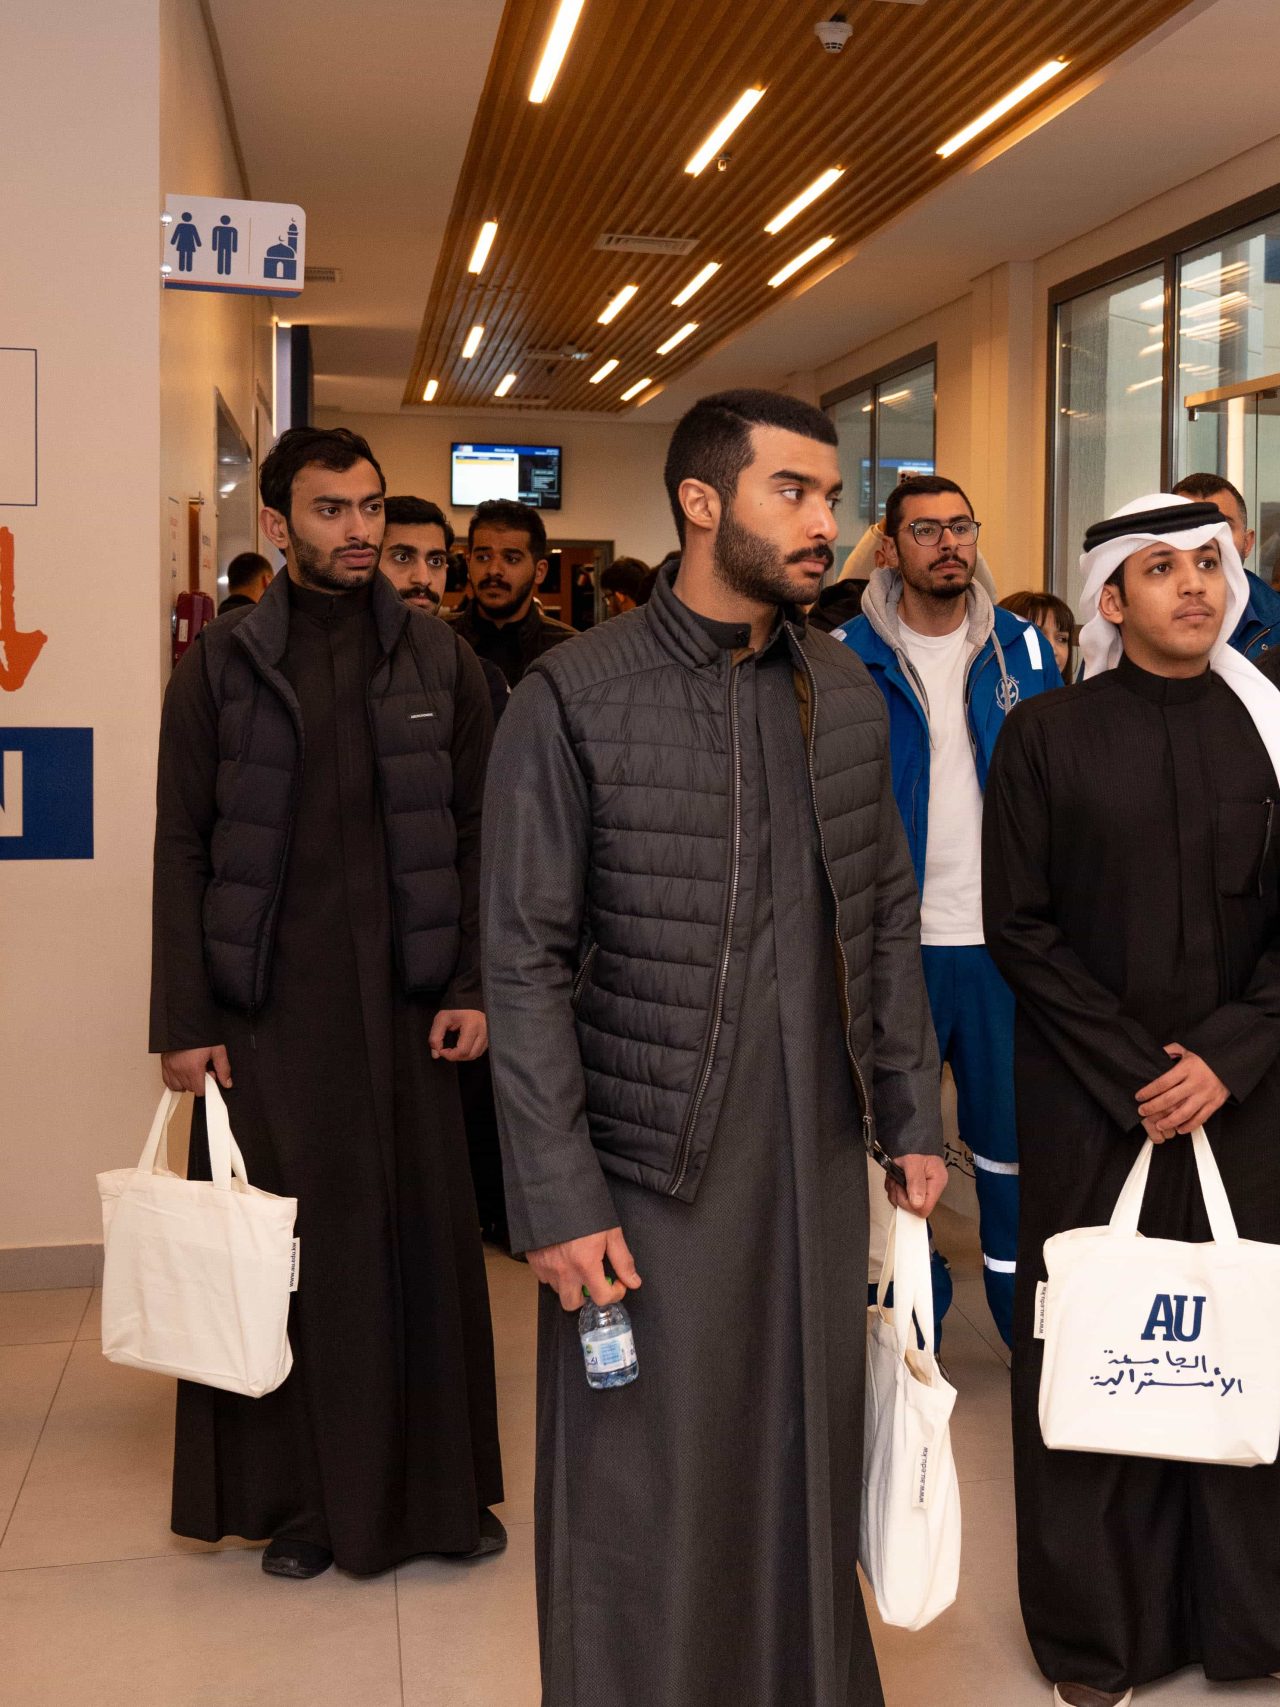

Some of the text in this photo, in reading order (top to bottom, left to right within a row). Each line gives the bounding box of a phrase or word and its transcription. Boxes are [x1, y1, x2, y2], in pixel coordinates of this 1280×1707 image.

[1141, 1293, 1206, 1342] AU
[1103, 1350, 1207, 1374] الجامعة
[1090, 1367, 1243, 1397] الأسترالية
[919, 1446, 928, 1503] www.au.edu.kw
